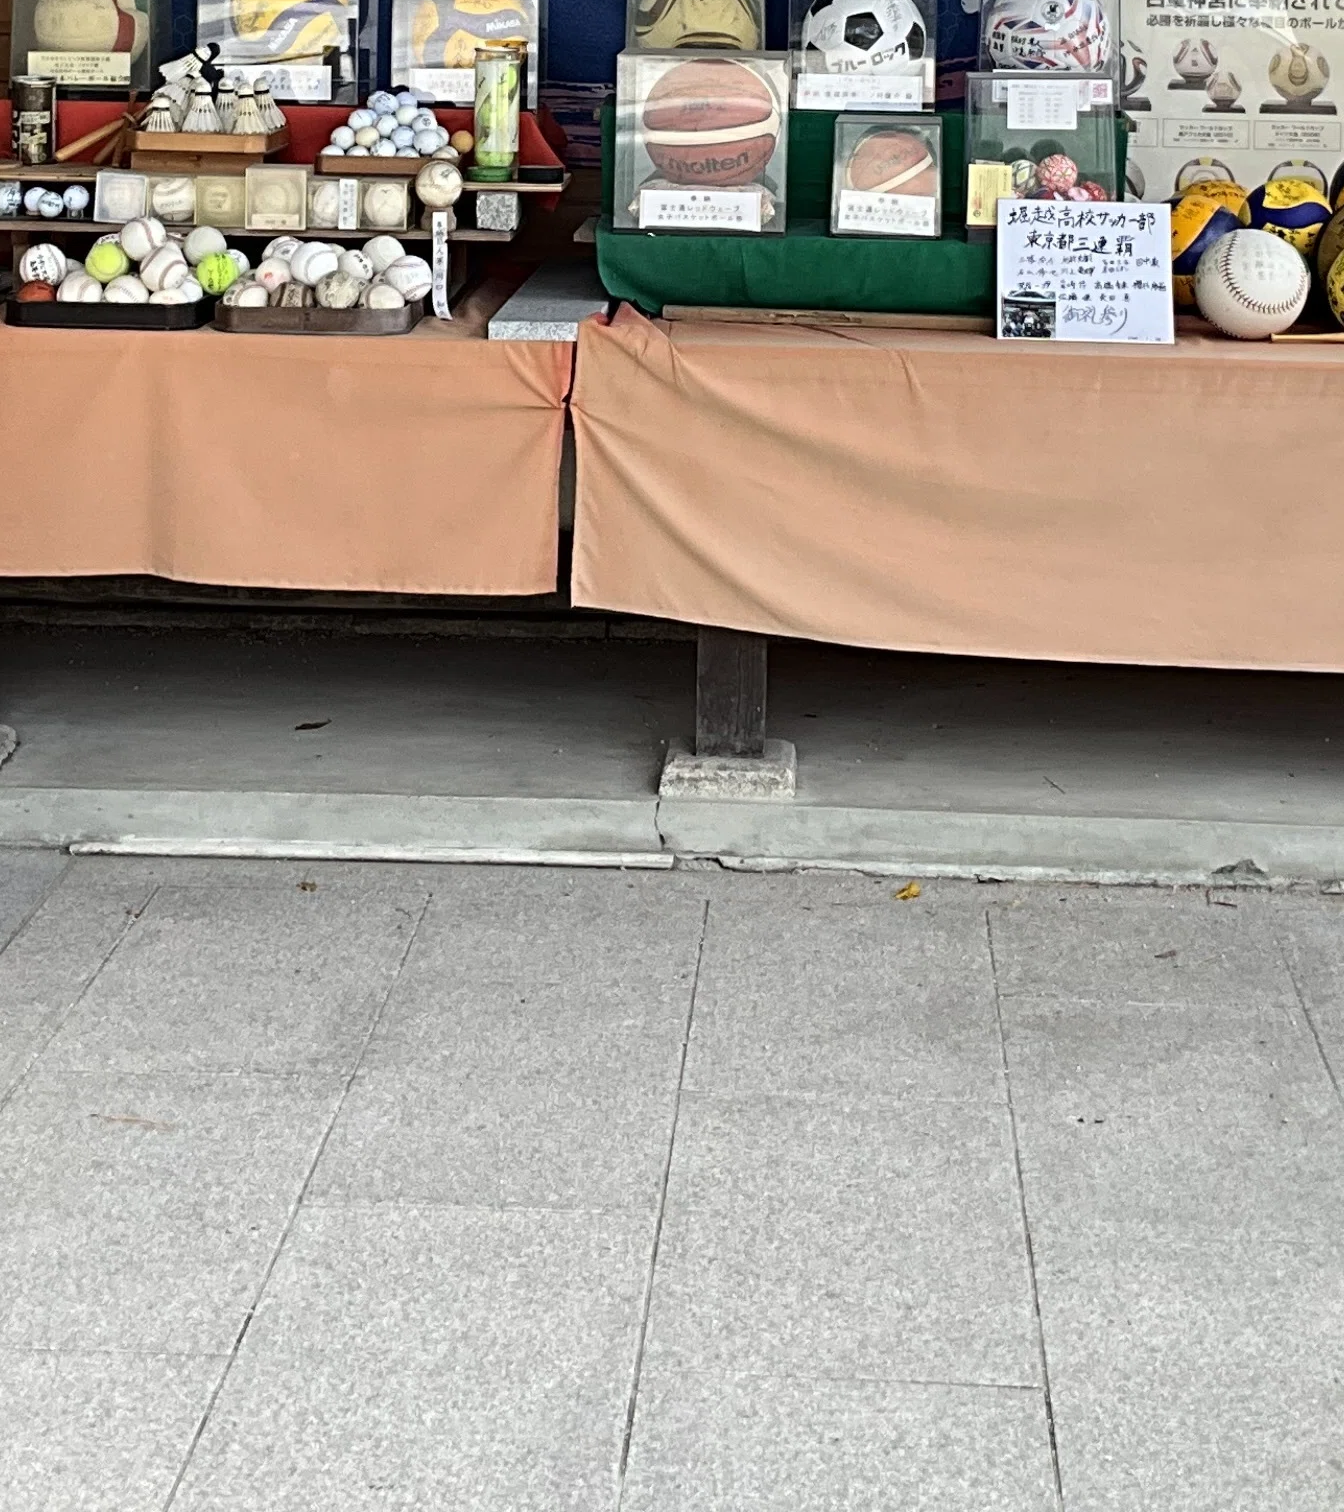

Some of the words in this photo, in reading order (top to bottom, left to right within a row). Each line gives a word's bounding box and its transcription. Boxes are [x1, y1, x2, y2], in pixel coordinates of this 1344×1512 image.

[1007, 205, 1157, 235] 堀越高校サッカー部
[1023, 228, 1136, 258] 東京都三連覇
